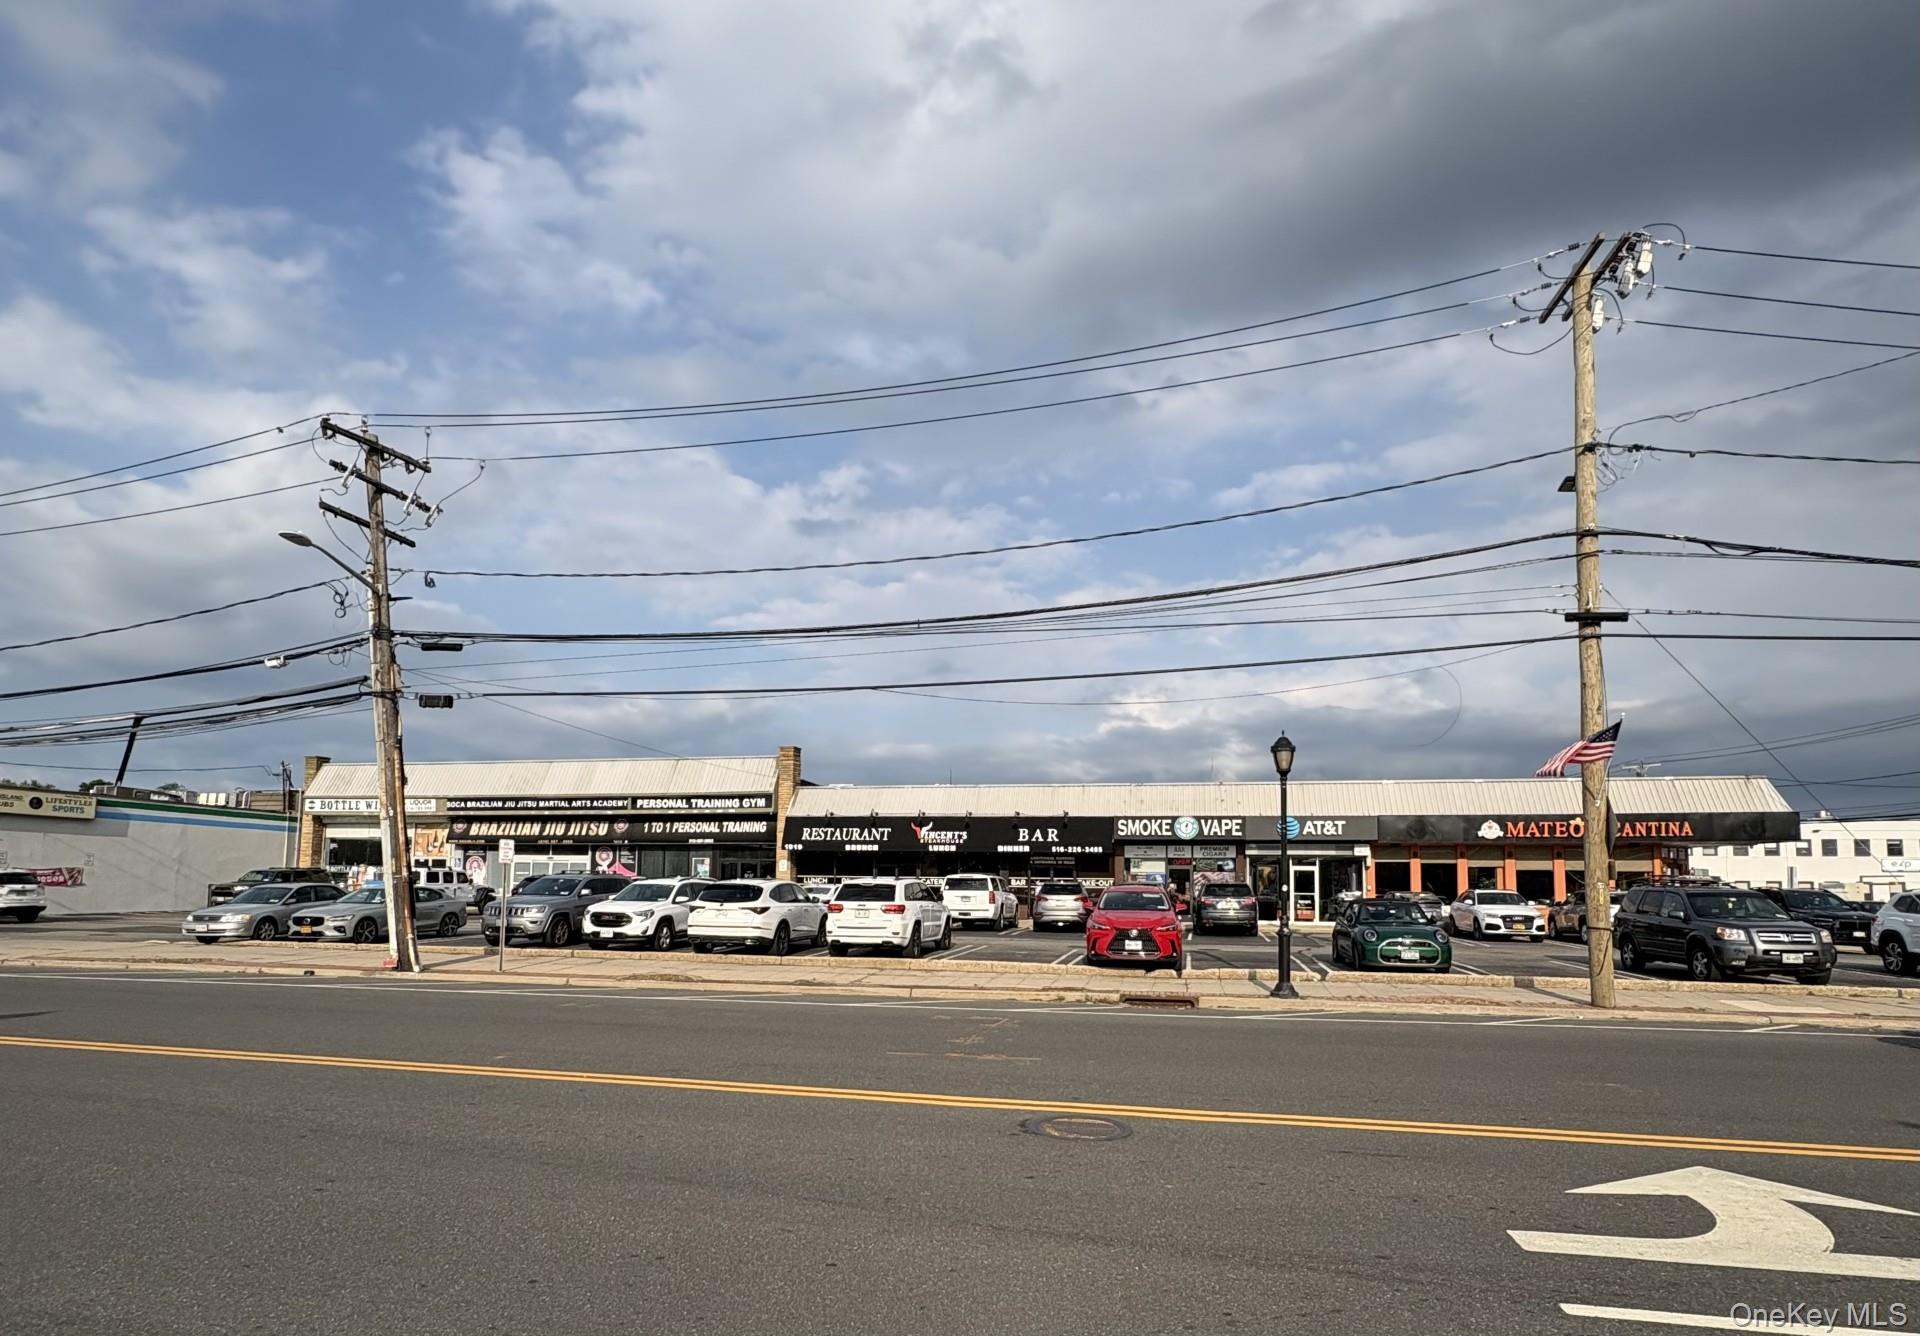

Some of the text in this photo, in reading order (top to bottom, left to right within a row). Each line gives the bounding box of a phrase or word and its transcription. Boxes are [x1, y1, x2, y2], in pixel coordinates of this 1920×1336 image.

[45, 796, 93, 807] LIFESTYLES
[320, 800, 379, 810] BOTTLE WI
[636, 798, 766, 809] PERSONAL TRAINING GYM
[52, 805, 85, 814] SPORTS
[469, 821, 609, 836] BRAZILIAN JIU JITSU
[643, 821, 767, 833] 1 TO 1 PERSONAL TRAINING
[1117, 819, 1172, 836] SMOKE
[1200, 819, 1242, 836] VAPE
[1302, 820, 1346, 835] AT&T
[1505, 820, 1584, 838] MATEO
[801, 827, 891, 841] RESTAURANT
[1017, 828, 1059, 842] BAR
[921, 877, 944, 885] CATER
